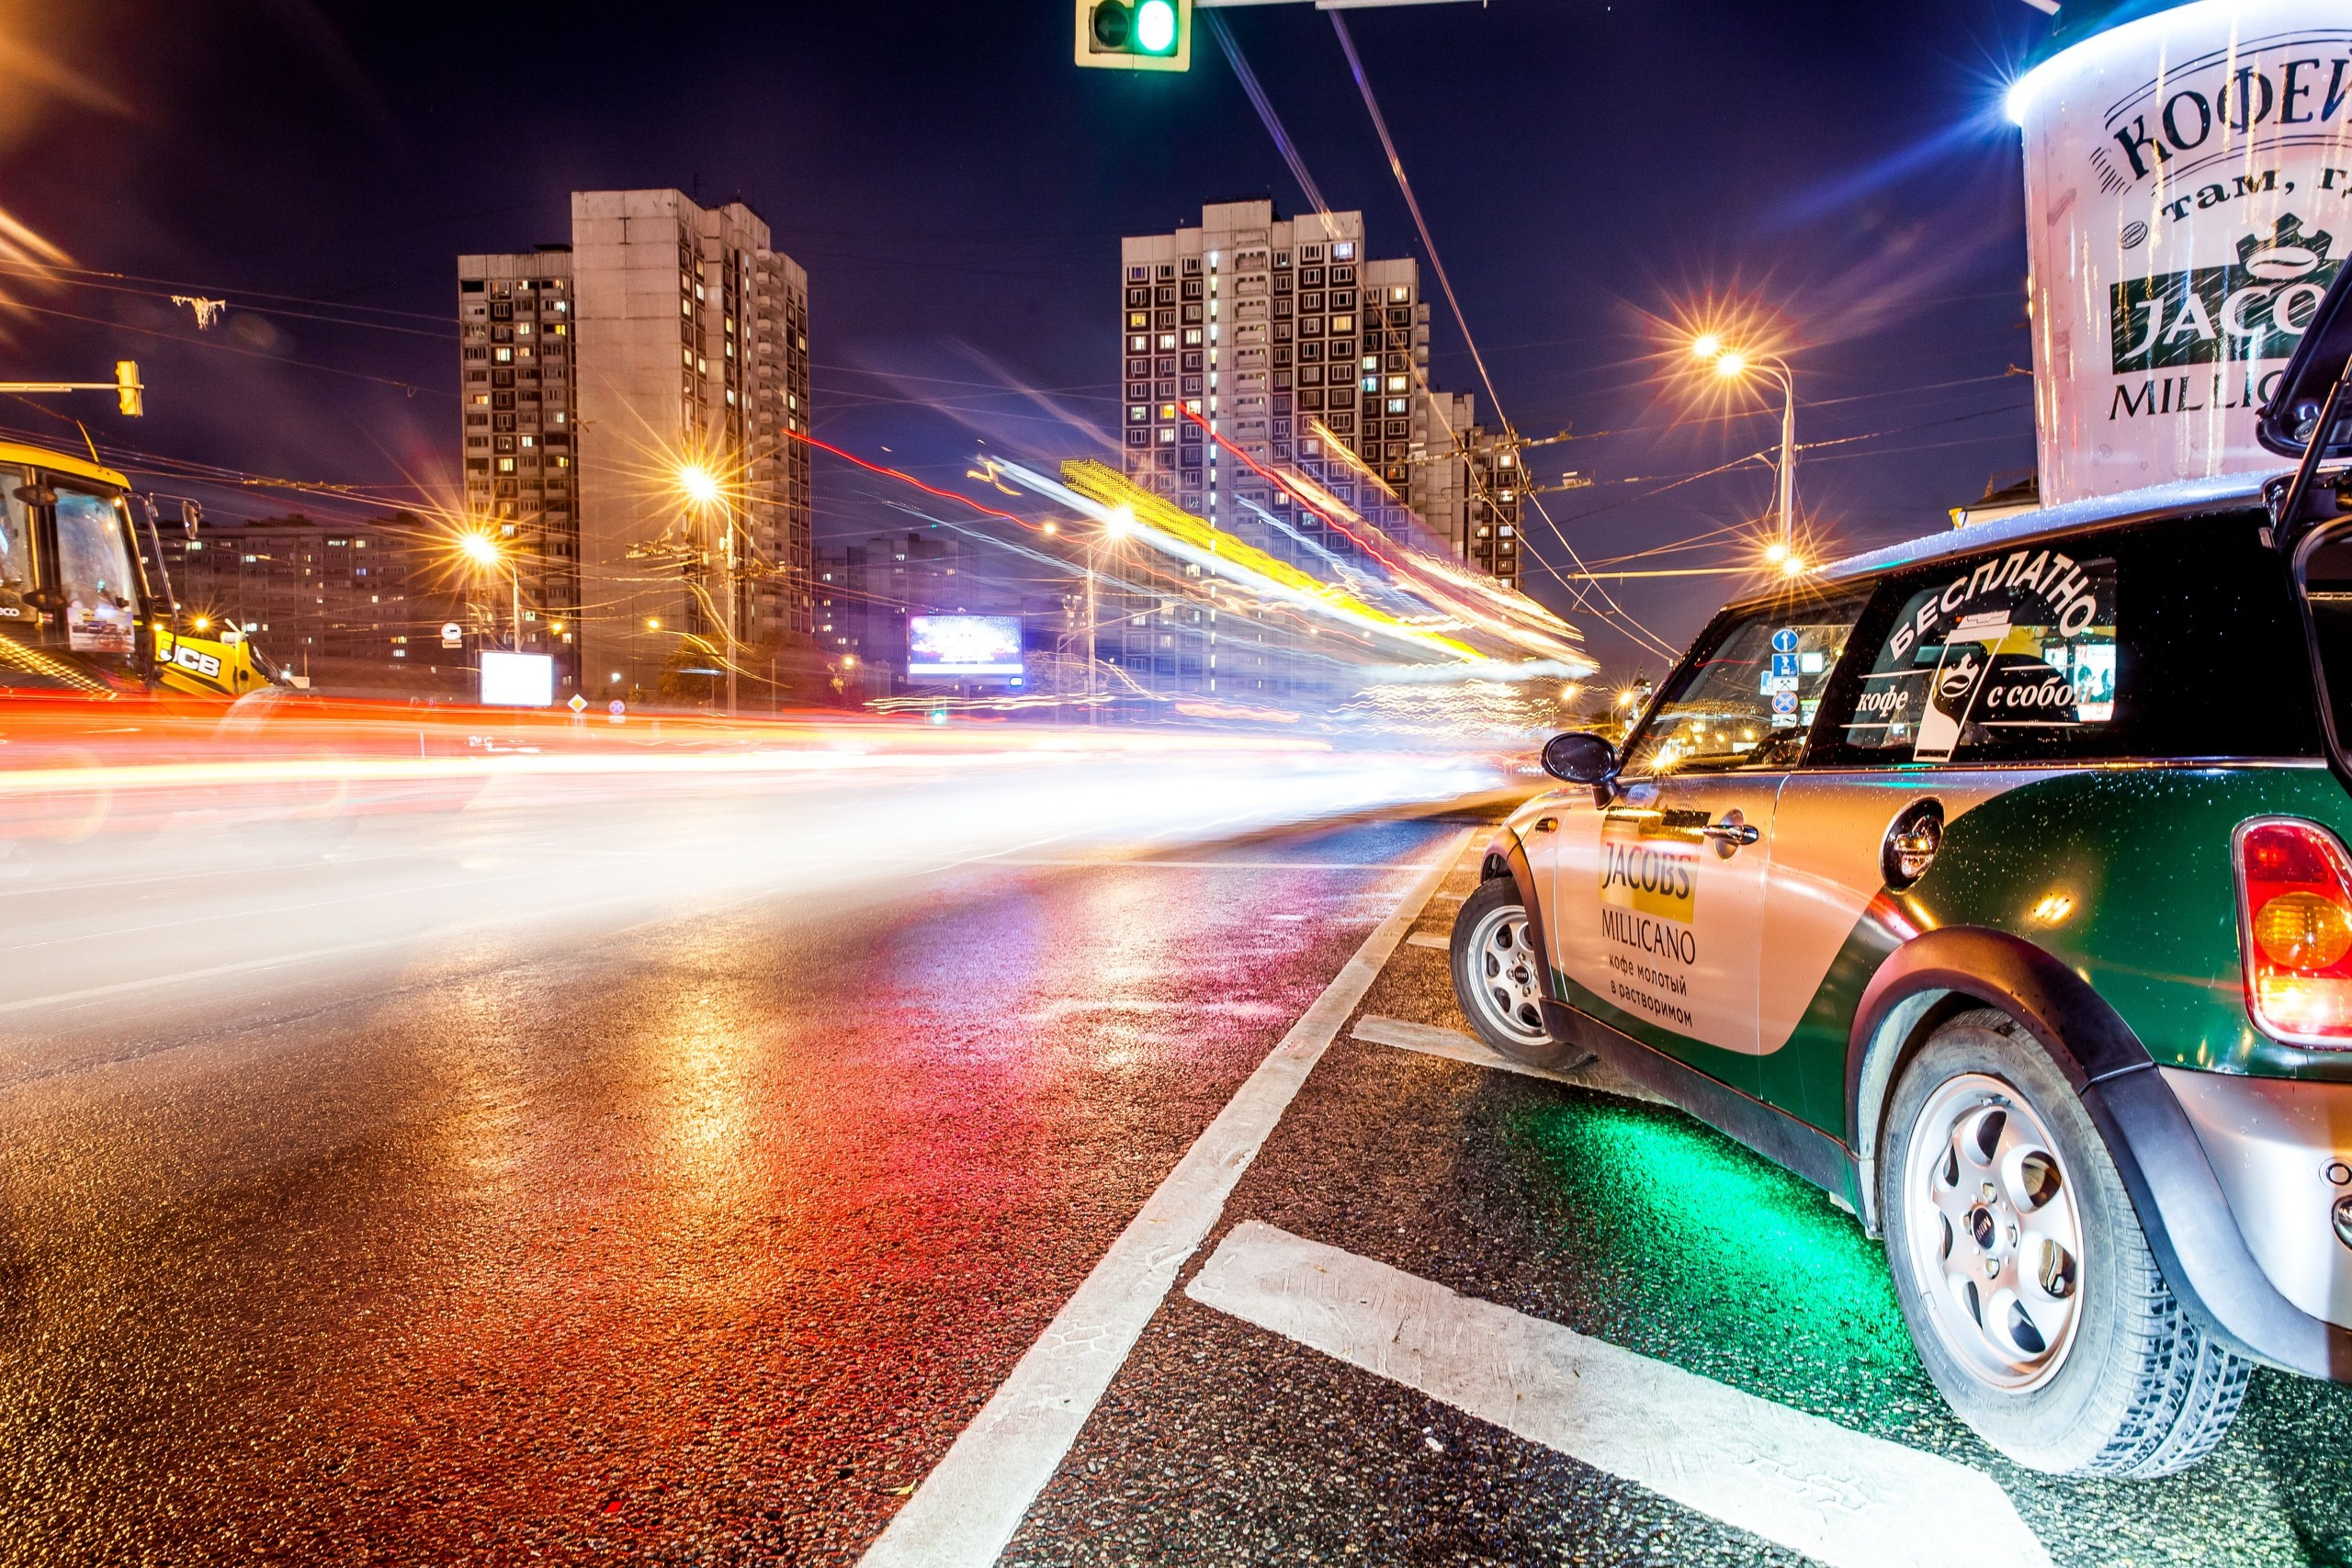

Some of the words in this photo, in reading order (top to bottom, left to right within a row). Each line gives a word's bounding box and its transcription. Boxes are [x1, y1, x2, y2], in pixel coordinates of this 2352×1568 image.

[2161, 168, 2295, 223] там,
[1889, 550, 2097, 660] БЕСПЛАТНО
[160, 644, 220, 677] JCB
[1856, 685, 1908, 717] кофе
[1987, 685, 2002, 707] с
[2007, 676, 2095, 707] собой
[1601, 842, 1691, 899] JACOBS
[1602, 908, 1696, 964] MILLICANO
[1609, 953, 1634, 976] кофе
[1637, 963, 1687, 997] молотый
[1611, 979, 1617, 994] в
[1619, 985, 1692, 1028] растворимом
